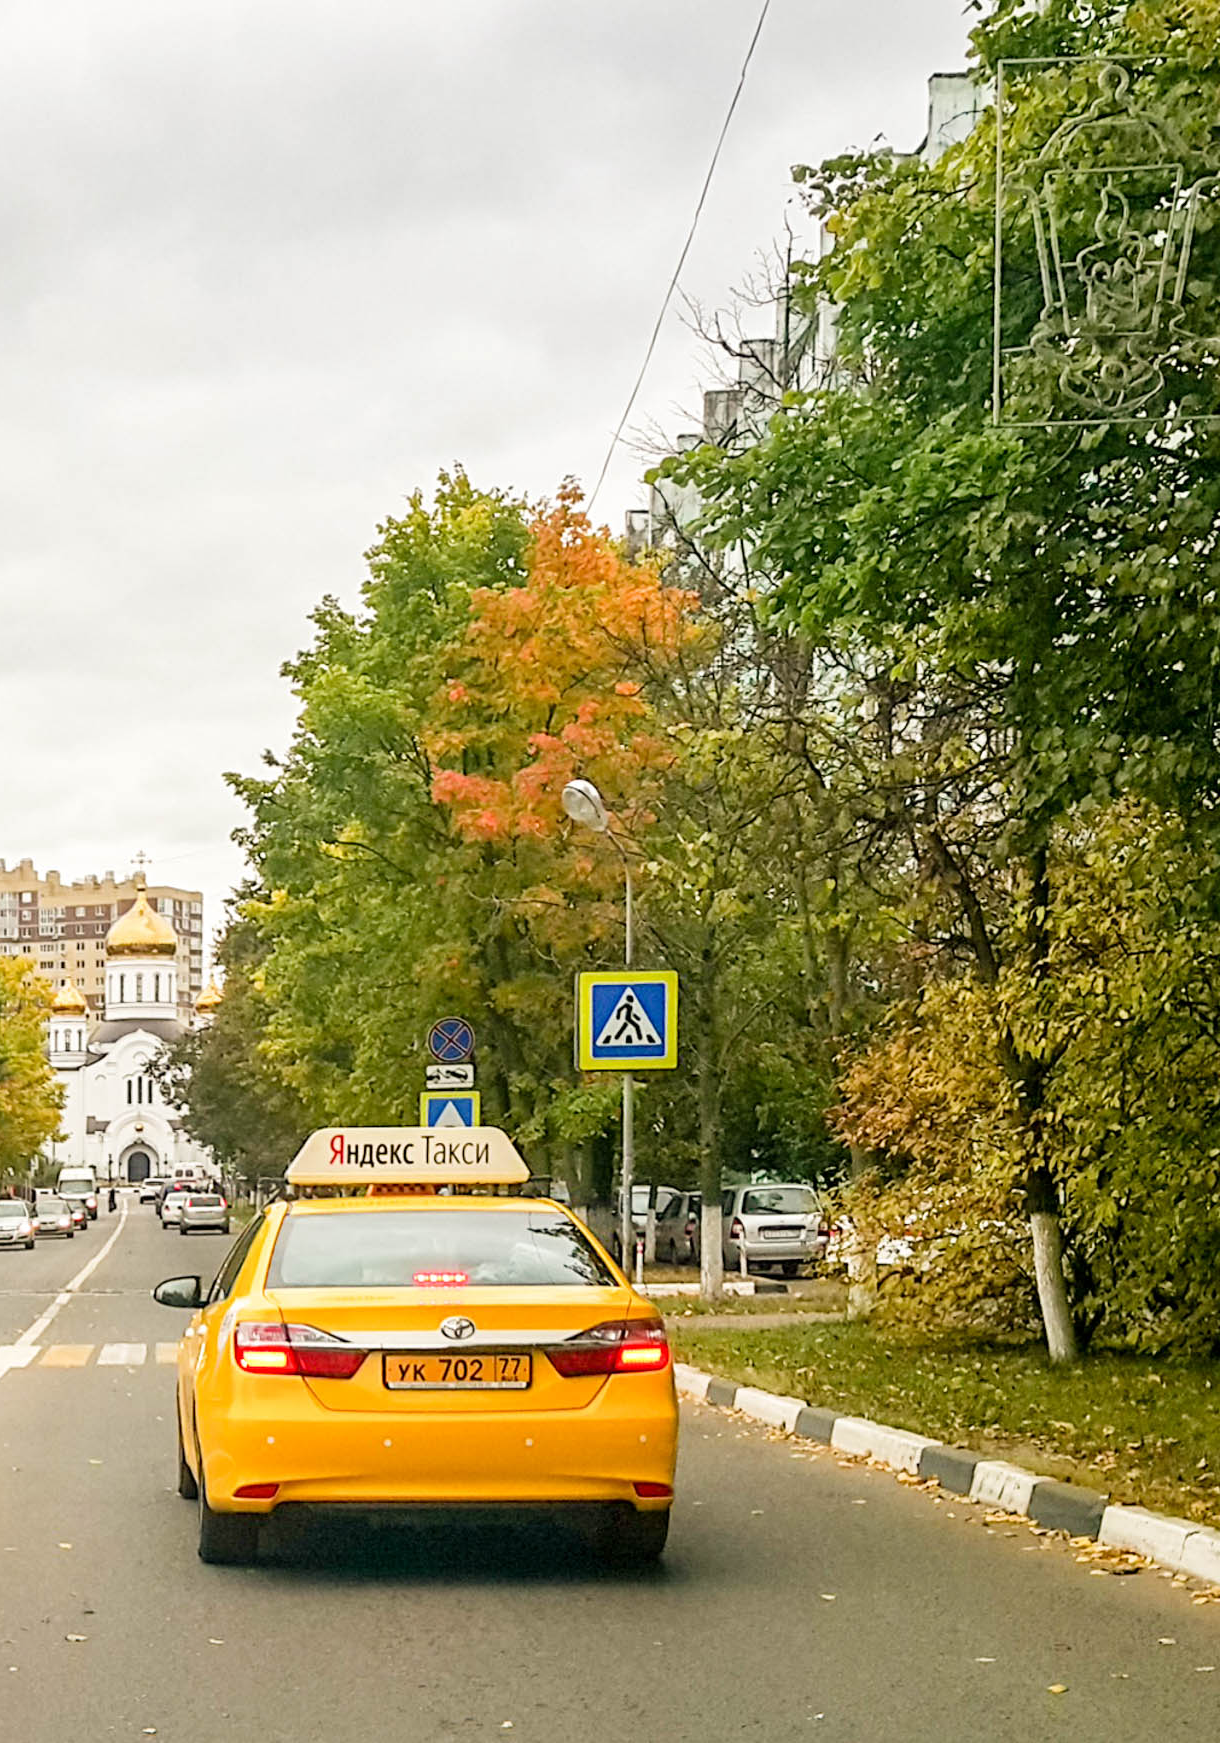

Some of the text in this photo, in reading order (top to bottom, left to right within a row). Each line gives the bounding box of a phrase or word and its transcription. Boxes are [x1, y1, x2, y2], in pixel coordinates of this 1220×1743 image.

[329, 1134, 490, 1168] Яндекс Такси
[438, 1358, 484, 1382] 702
[498, 1357, 522, 1375] 77
